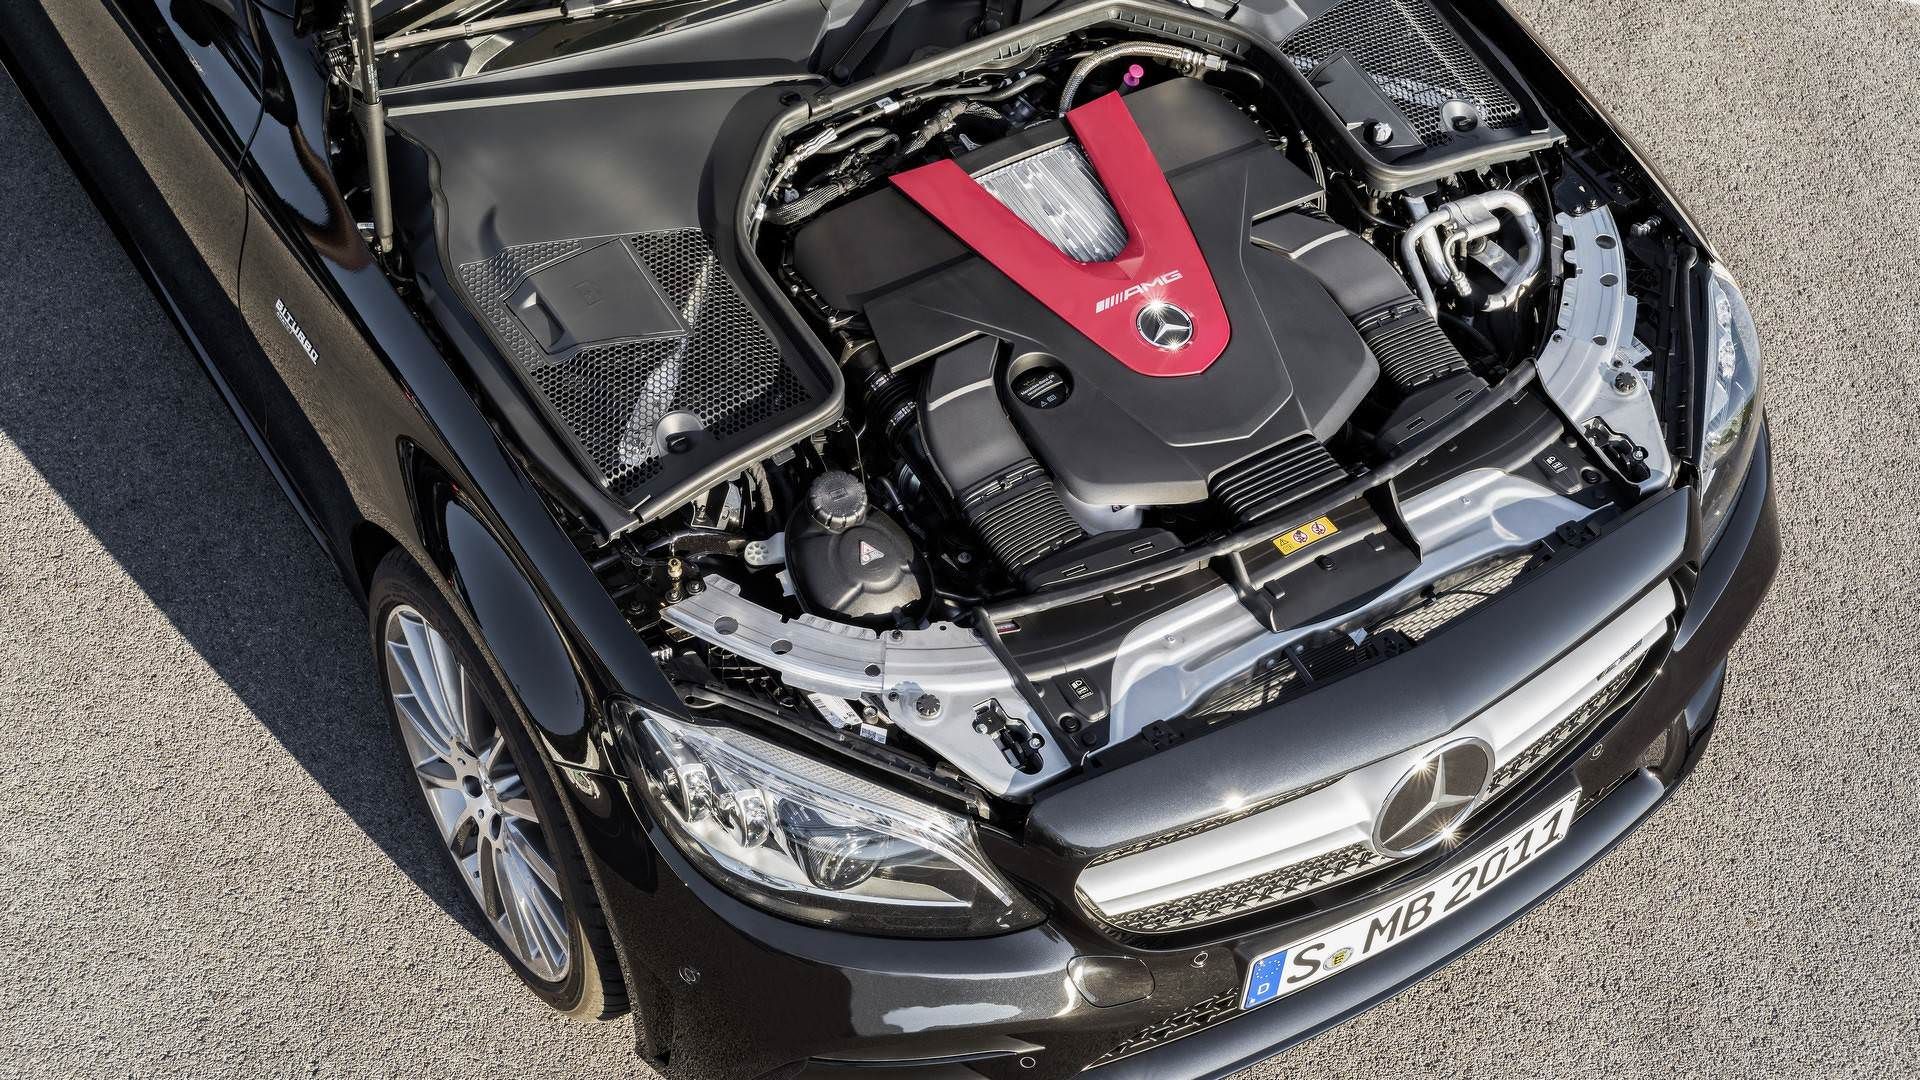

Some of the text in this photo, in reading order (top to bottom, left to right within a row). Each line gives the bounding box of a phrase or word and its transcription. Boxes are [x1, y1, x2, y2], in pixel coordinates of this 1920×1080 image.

[275, 298, 319, 365] BITURBO
[1257, 808, 1565, 995] D S MB 2011
